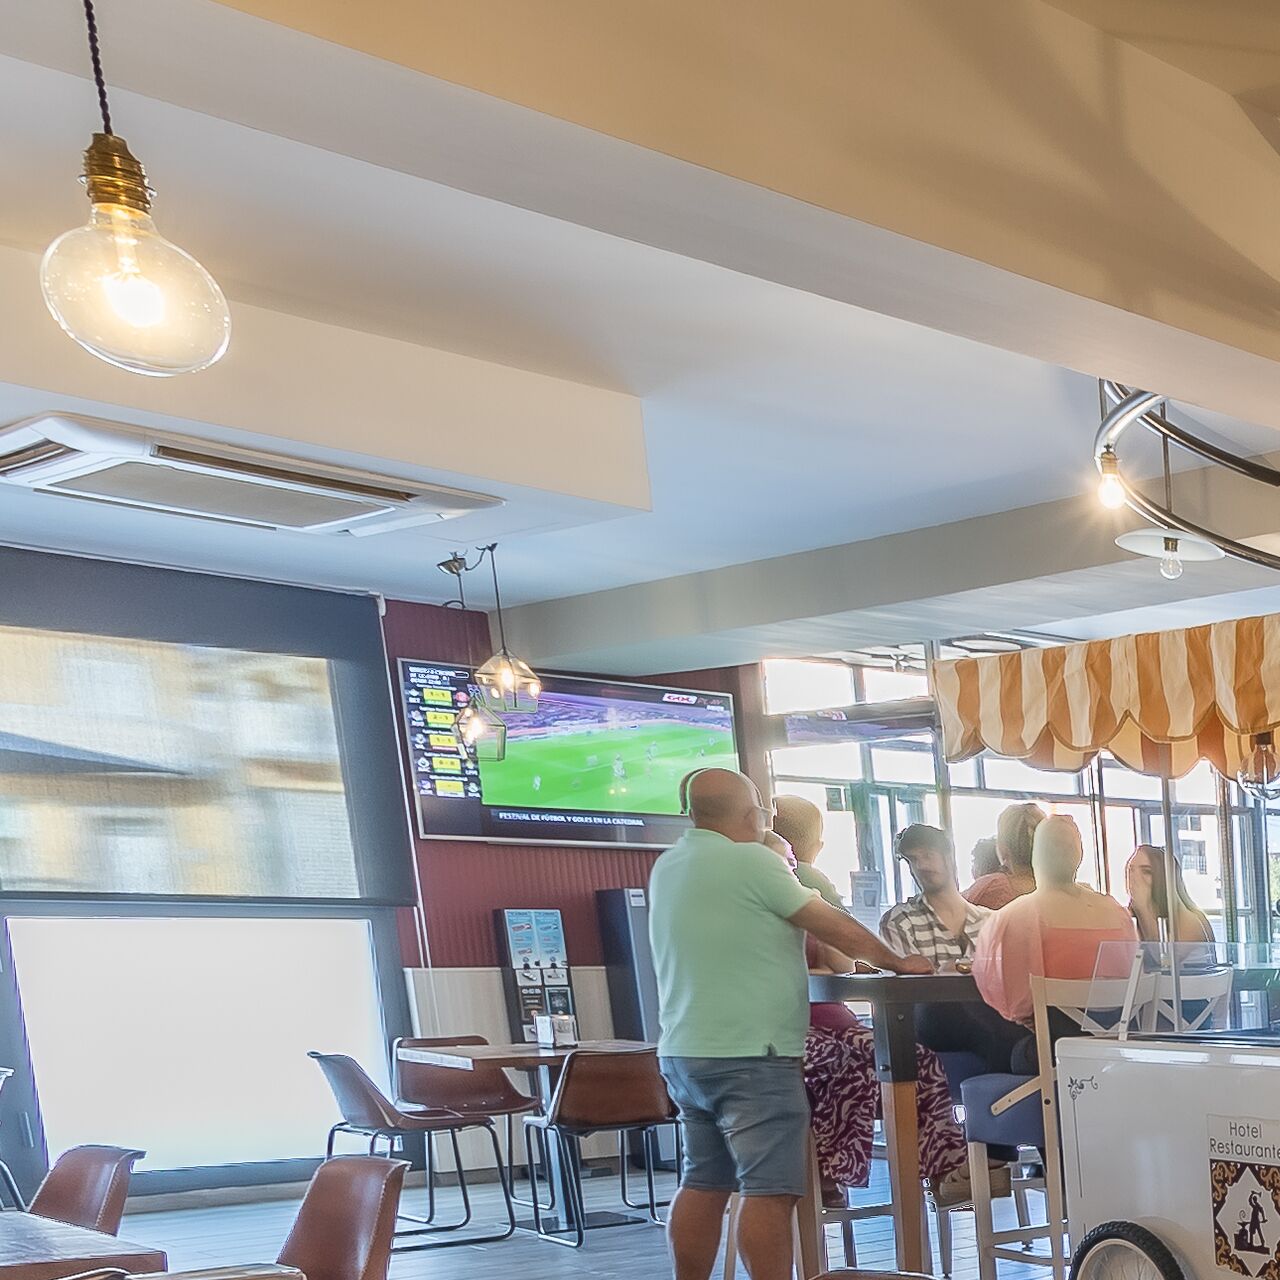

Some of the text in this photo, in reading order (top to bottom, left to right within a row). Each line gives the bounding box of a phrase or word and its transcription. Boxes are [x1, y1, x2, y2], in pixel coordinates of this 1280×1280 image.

[499, 812, 531, 821] FESTIVAL
[531, 813, 540, 821] DE
[541, 813, 566, 823] FÚTBOL
[593, 816, 603, 824] EN
[603, 817, 612, 825] LA
[612, 817, 645, 827] CATEDRAL
[1228, 1121, 1263, 1139] Hotel
